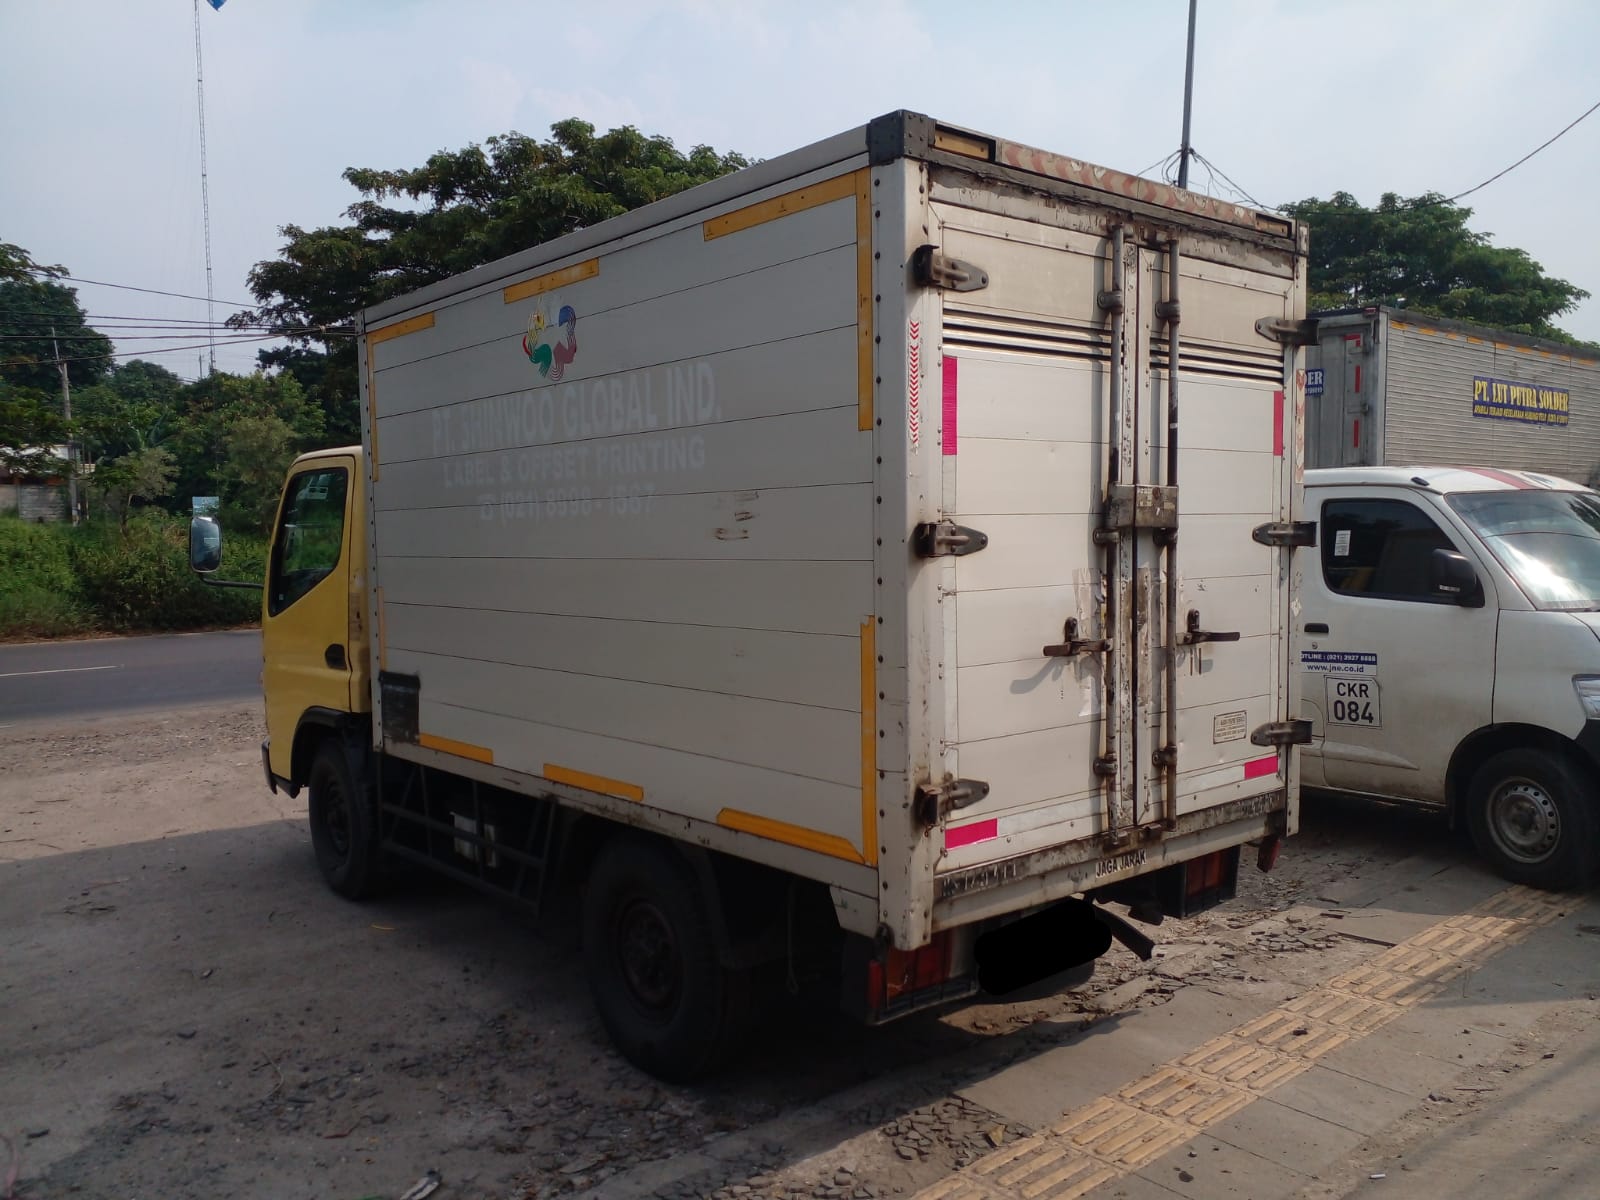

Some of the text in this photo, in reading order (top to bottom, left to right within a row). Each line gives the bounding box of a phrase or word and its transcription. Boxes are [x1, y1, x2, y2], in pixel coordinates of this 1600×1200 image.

[1304, 371, 1323, 385] ER
[431, 361, 722, 454] PT. SHINWOO GLOBAL IND.
[1474, 380, 1489, 402] PT.
[1510, 385, 1537, 408] PUTRA
[1539, 389, 1568, 412] SOLDER
[442, 458, 494, 488] LABEL
[519, 447, 588, 481] OFFSET
[598, 434, 705, 475] PRINTING
[1307, 664, 1364, 673] www.jne.co.id
[1326, 654, 1342, 662] (021)
[1336, 682, 1369, 698] CKR
[1333, 699, 1374, 724] 084
[1096, 849, 1146, 877] JAGA JARAK
